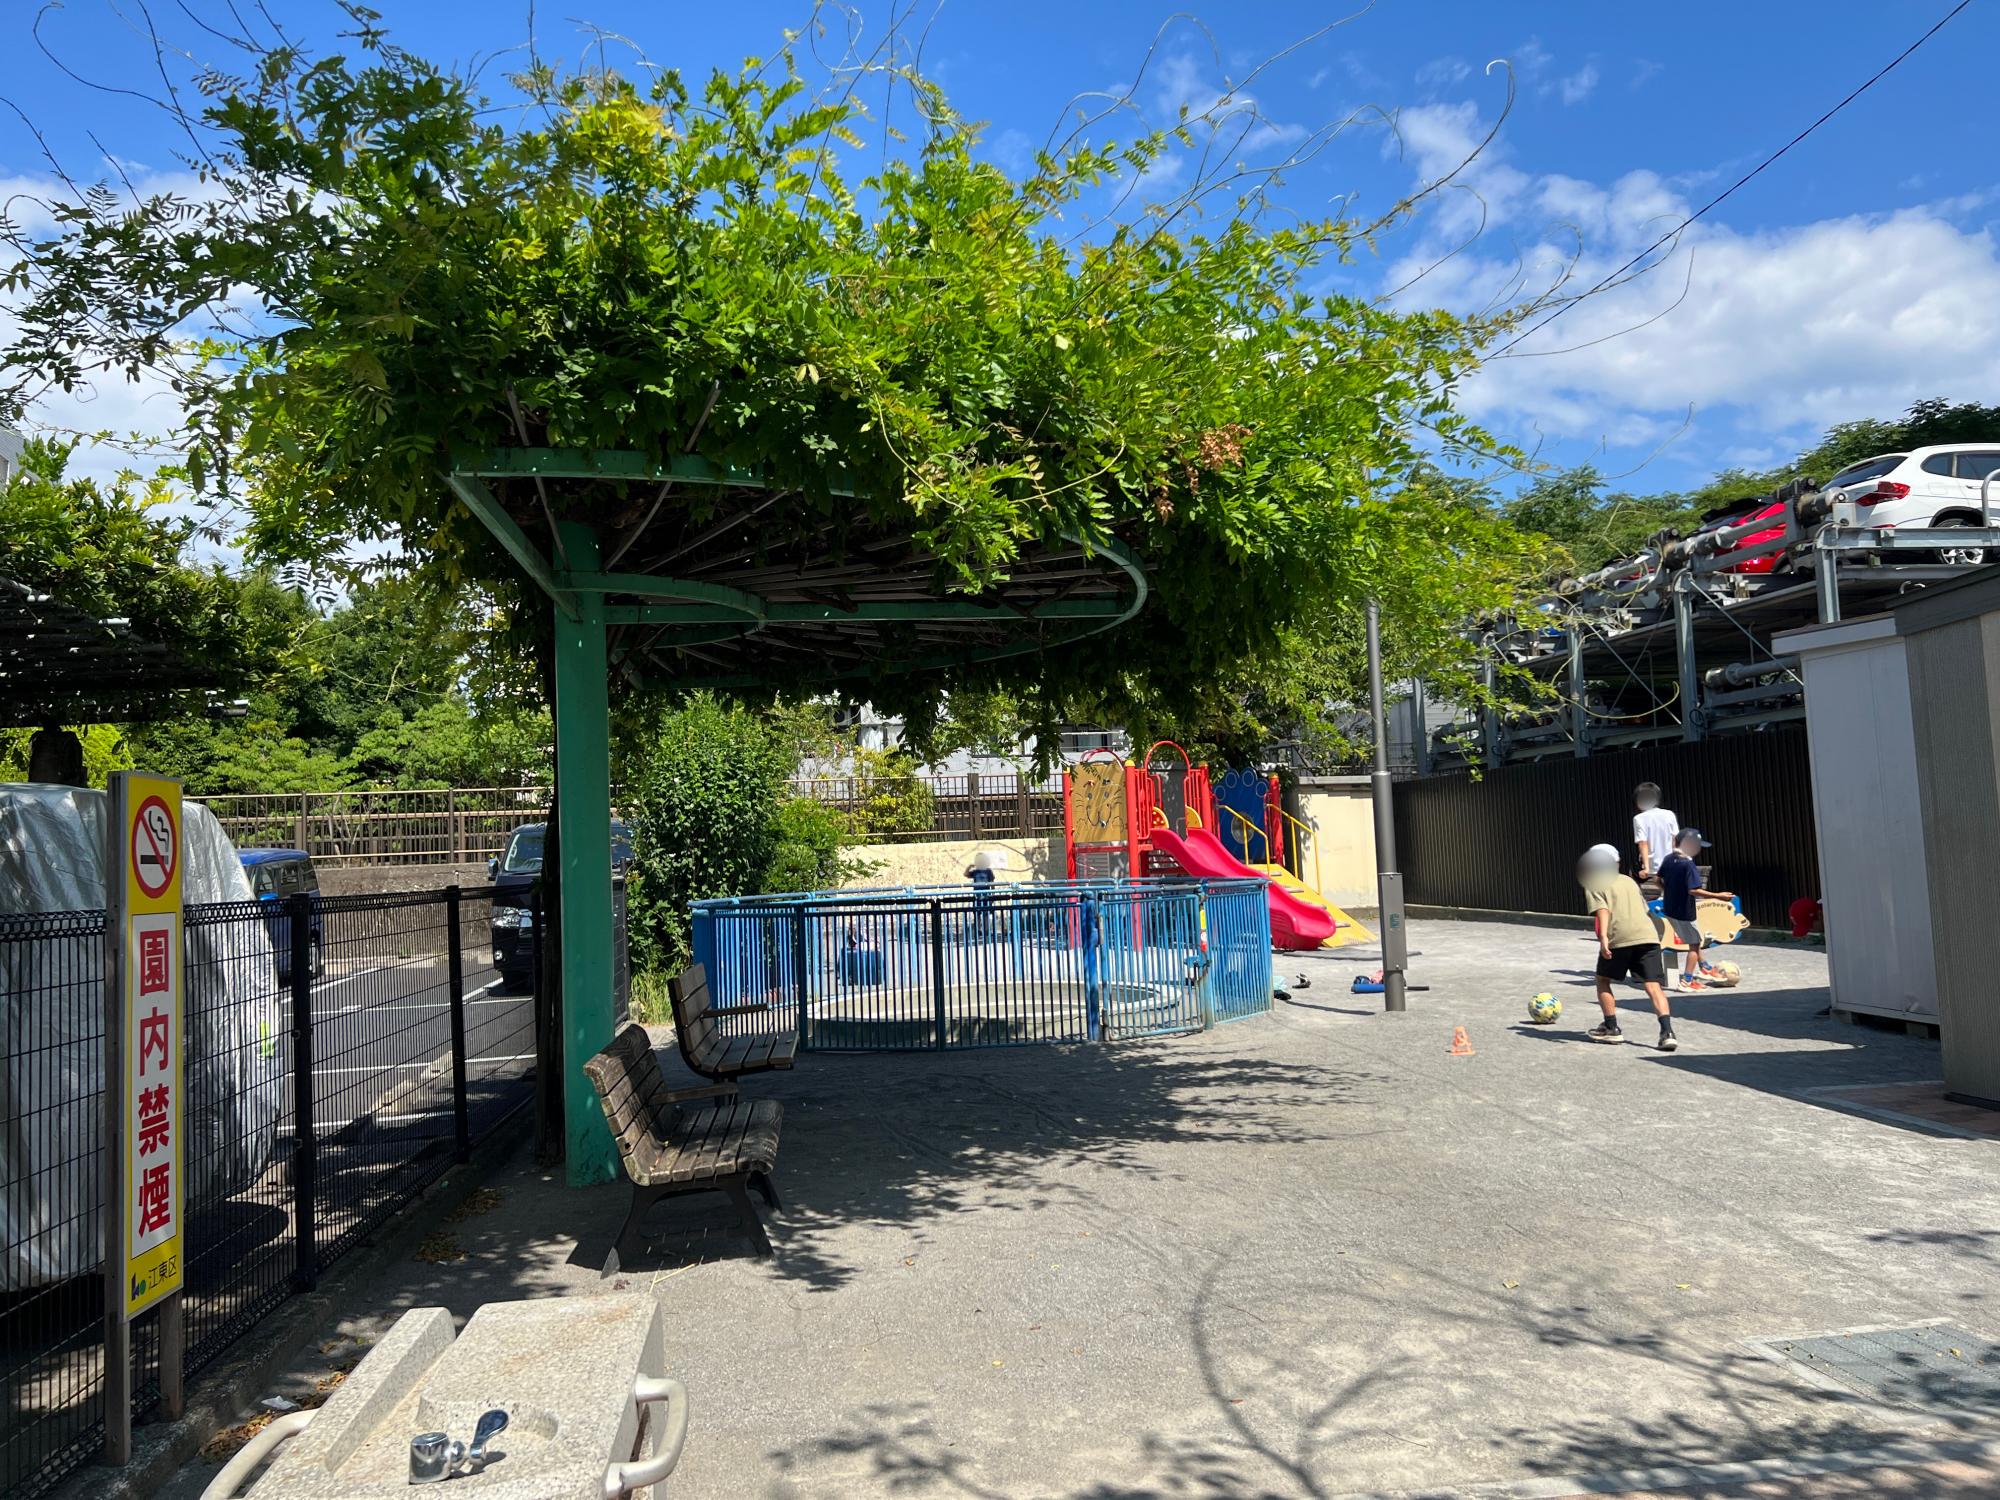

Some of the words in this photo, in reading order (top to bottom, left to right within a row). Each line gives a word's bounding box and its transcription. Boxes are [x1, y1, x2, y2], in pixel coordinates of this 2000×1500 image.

[138, 929, 170, 1239] 園内禁煙
[149, 1255, 177, 1289] 江東区
